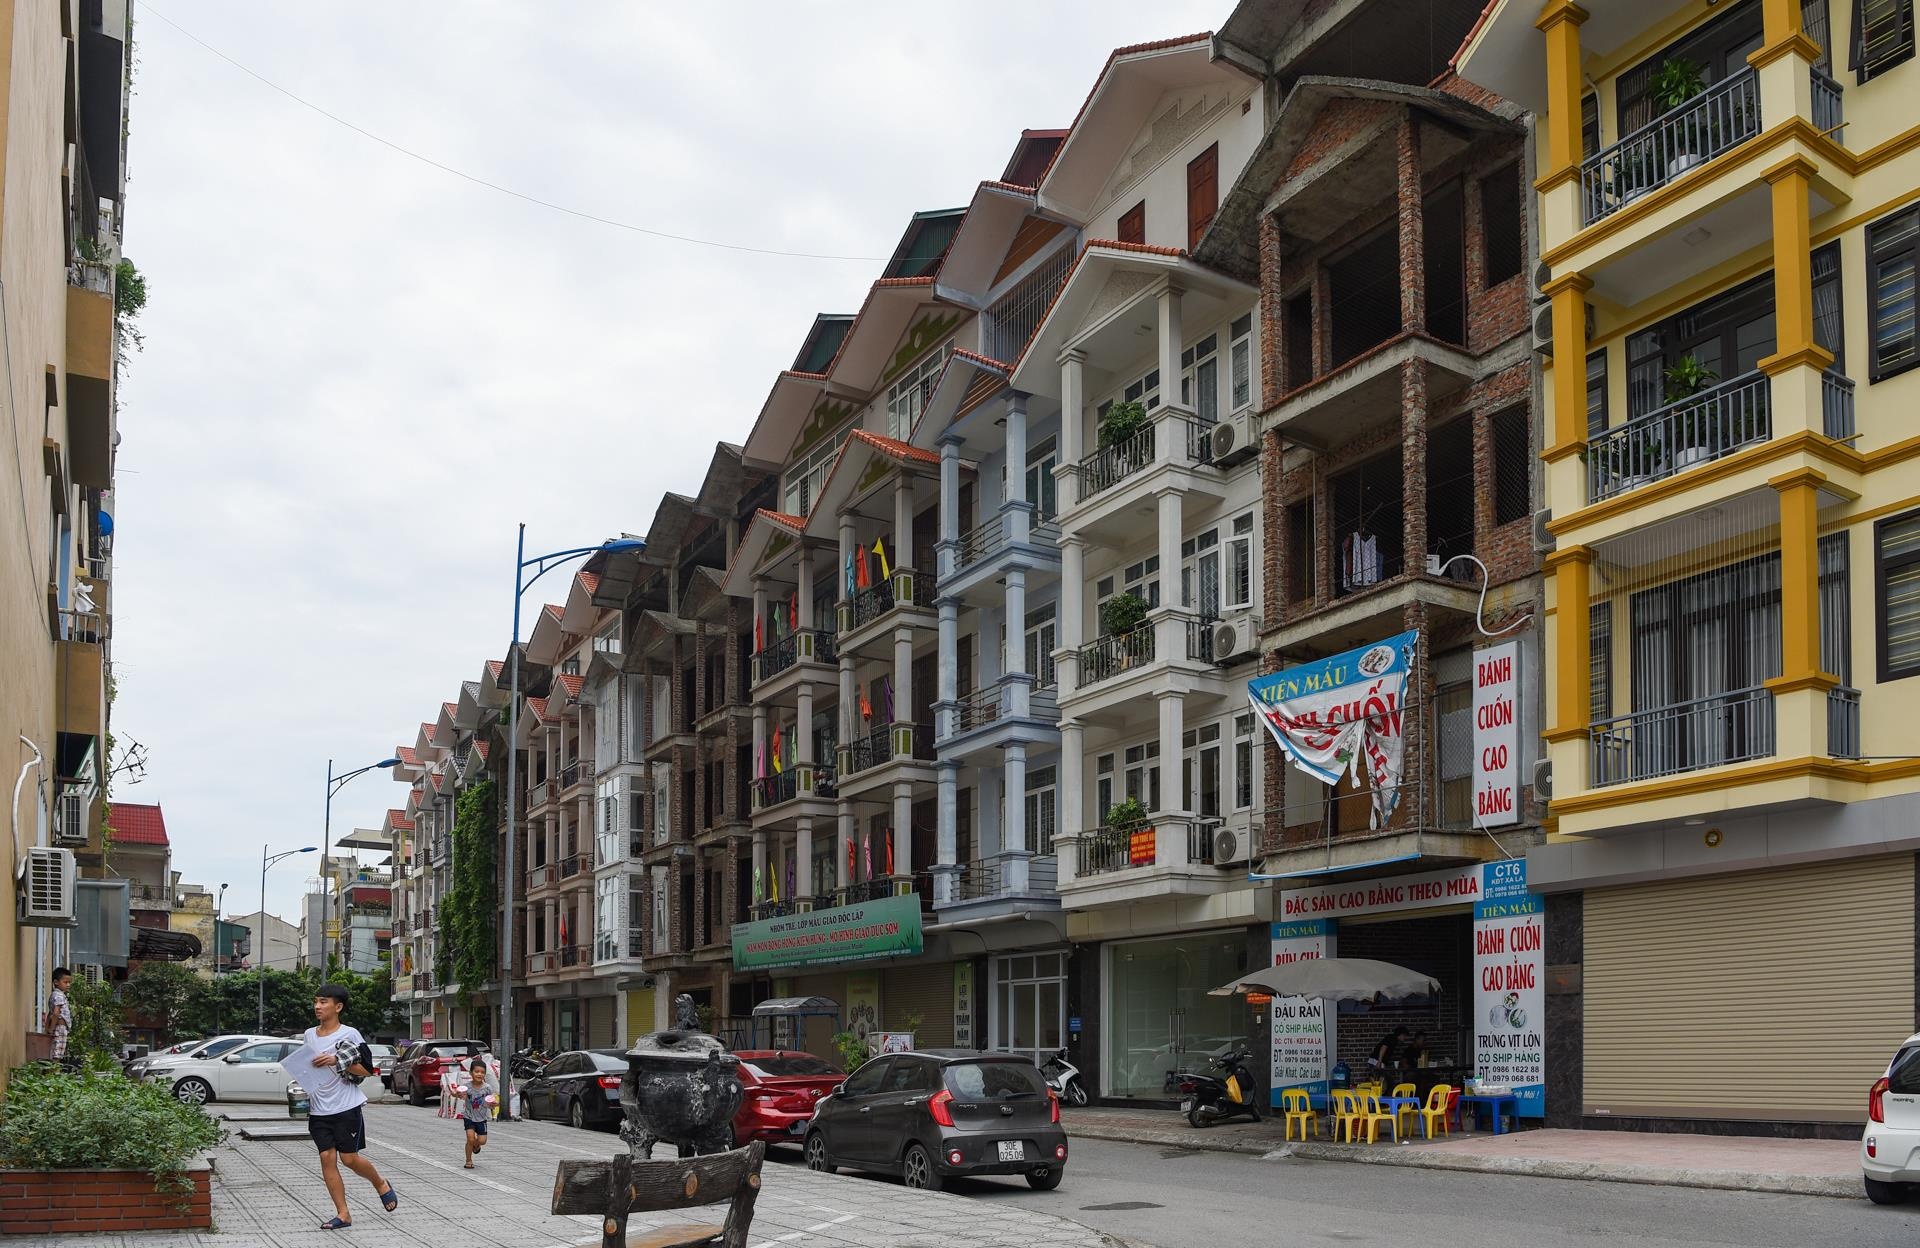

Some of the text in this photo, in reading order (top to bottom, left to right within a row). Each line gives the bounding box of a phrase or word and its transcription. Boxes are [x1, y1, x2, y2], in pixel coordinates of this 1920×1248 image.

[1478, 656, 1511, 688] BÁNH
[1478, 693, 1512, 730] CUỐN
[1483, 744, 1508, 772] CAO
[1479, 781, 1511, 815] BẰNG
[1495, 863, 1520, 877] CT6
[1285, 873, 1478, 916] ĐẶC SẢN CAO BẰNG THEO MÙA
[1477, 917, 1540, 955] BÁNH CUỐN
[1483, 955, 1535, 991] CAO BẰNG
[1275, 1001, 1321, 1021] ĐẬU RÁN
[1274, 1020, 1323, 1033] CÓ SHIP HÀNG
[1478, 1030, 1540, 1051] TRỨNG VỊT LỘN
[1478, 1050, 1540, 1063] CÓ SHIP HÀNG
[1004, 1141, 1017, 1150] 30E
